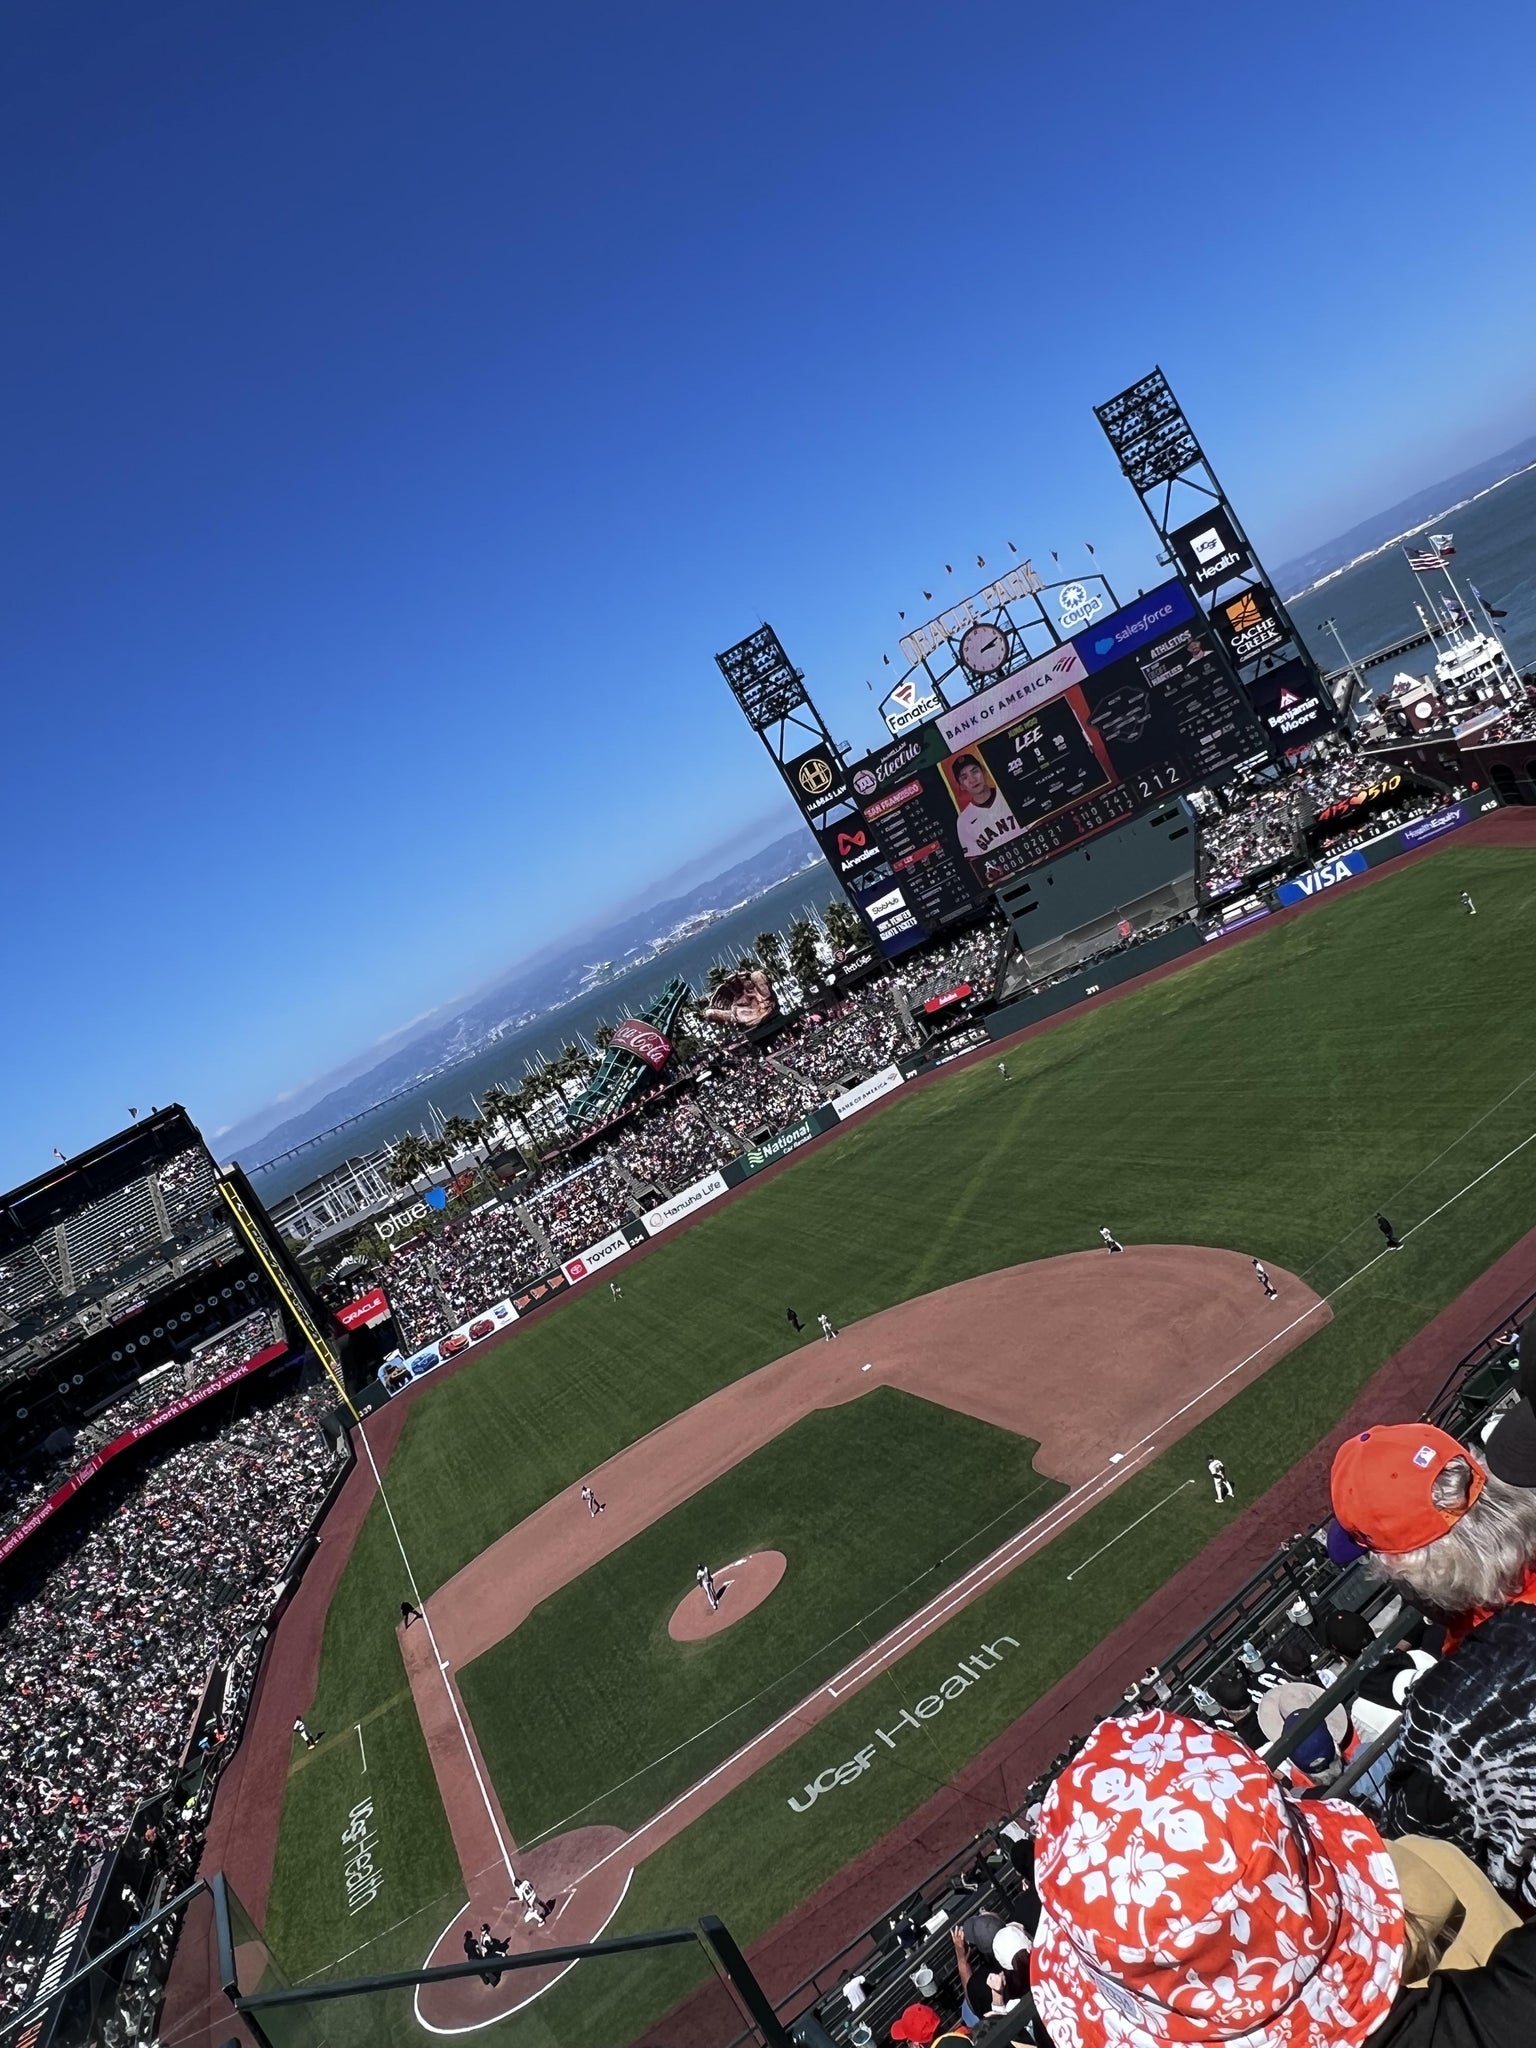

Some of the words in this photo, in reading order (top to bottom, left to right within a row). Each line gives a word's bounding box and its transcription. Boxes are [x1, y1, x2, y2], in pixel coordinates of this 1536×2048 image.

[1195, 552, 1241, 582] Health
[899, 602, 982, 667] ORACLE
[981, 560, 1046, 610] PARK
[1062, 599, 1101, 625] coupa
[1115, 603, 1173, 642] salesforce
[1150, 630, 1192, 659] ATHLETICS
[1231, 617, 1277, 647] CACHE
[1236, 628, 1280, 656] CREEK
[889, 694, 942, 731] Fanatics
[946, 716, 979, 739] BANK
[980, 705, 996, 719] OF
[999, 674, 1053, 711] AMERICA
[1268, 696, 1319, 727] Benjamin
[1280, 710, 1317, 734] Moore
[1014, 725, 1044, 753] LEE
[875, 743, 921, 782] Electric
[833, 784, 847, 800] LAW
[1139, 782, 1153, 798] 2
[1154, 775, 1163, 789] 1
[1166, 767, 1180, 784] 2
[1366, 775, 1401, 800] 510
[865, 803, 881, 818] SAN
[880, 784, 920, 807] FRANCISCO
[1480, 800, 1498, 812] 415
[1404, 809, 1462, 840] HealthEquity
[1294, 860, 1353, 897] VISA
[838, 1102, 854, 1113] BANK
[854, 1096, 862, 1104] OF
[862, 1081, 888, 1099] AMERICA
[762, 1121, 811, 1158] National
[663, 1192, 703, 1218] Hanwha
[701, 1180, 721, 1196] Life
[586, 1239, 625, 1265] TOYOTA
[342, 1298, 382, 1325] ORACLE
[132, 1423, 152, 1438] Fan
[152, 1408, 180, 1425] work
[179, 1401, 189, 1410] is
[189, 1380, 221, 1404] thirsty
[222, 1365, 249, 1384] work
[358, 1404, 372, 1418] 339
[787, 1743, 876, 1812] UCSF
[874, 1636, 1021, 1748] Health
[341, 1795, 374, 1845] UCSF
[344, 1829, 384, 1916] Health
